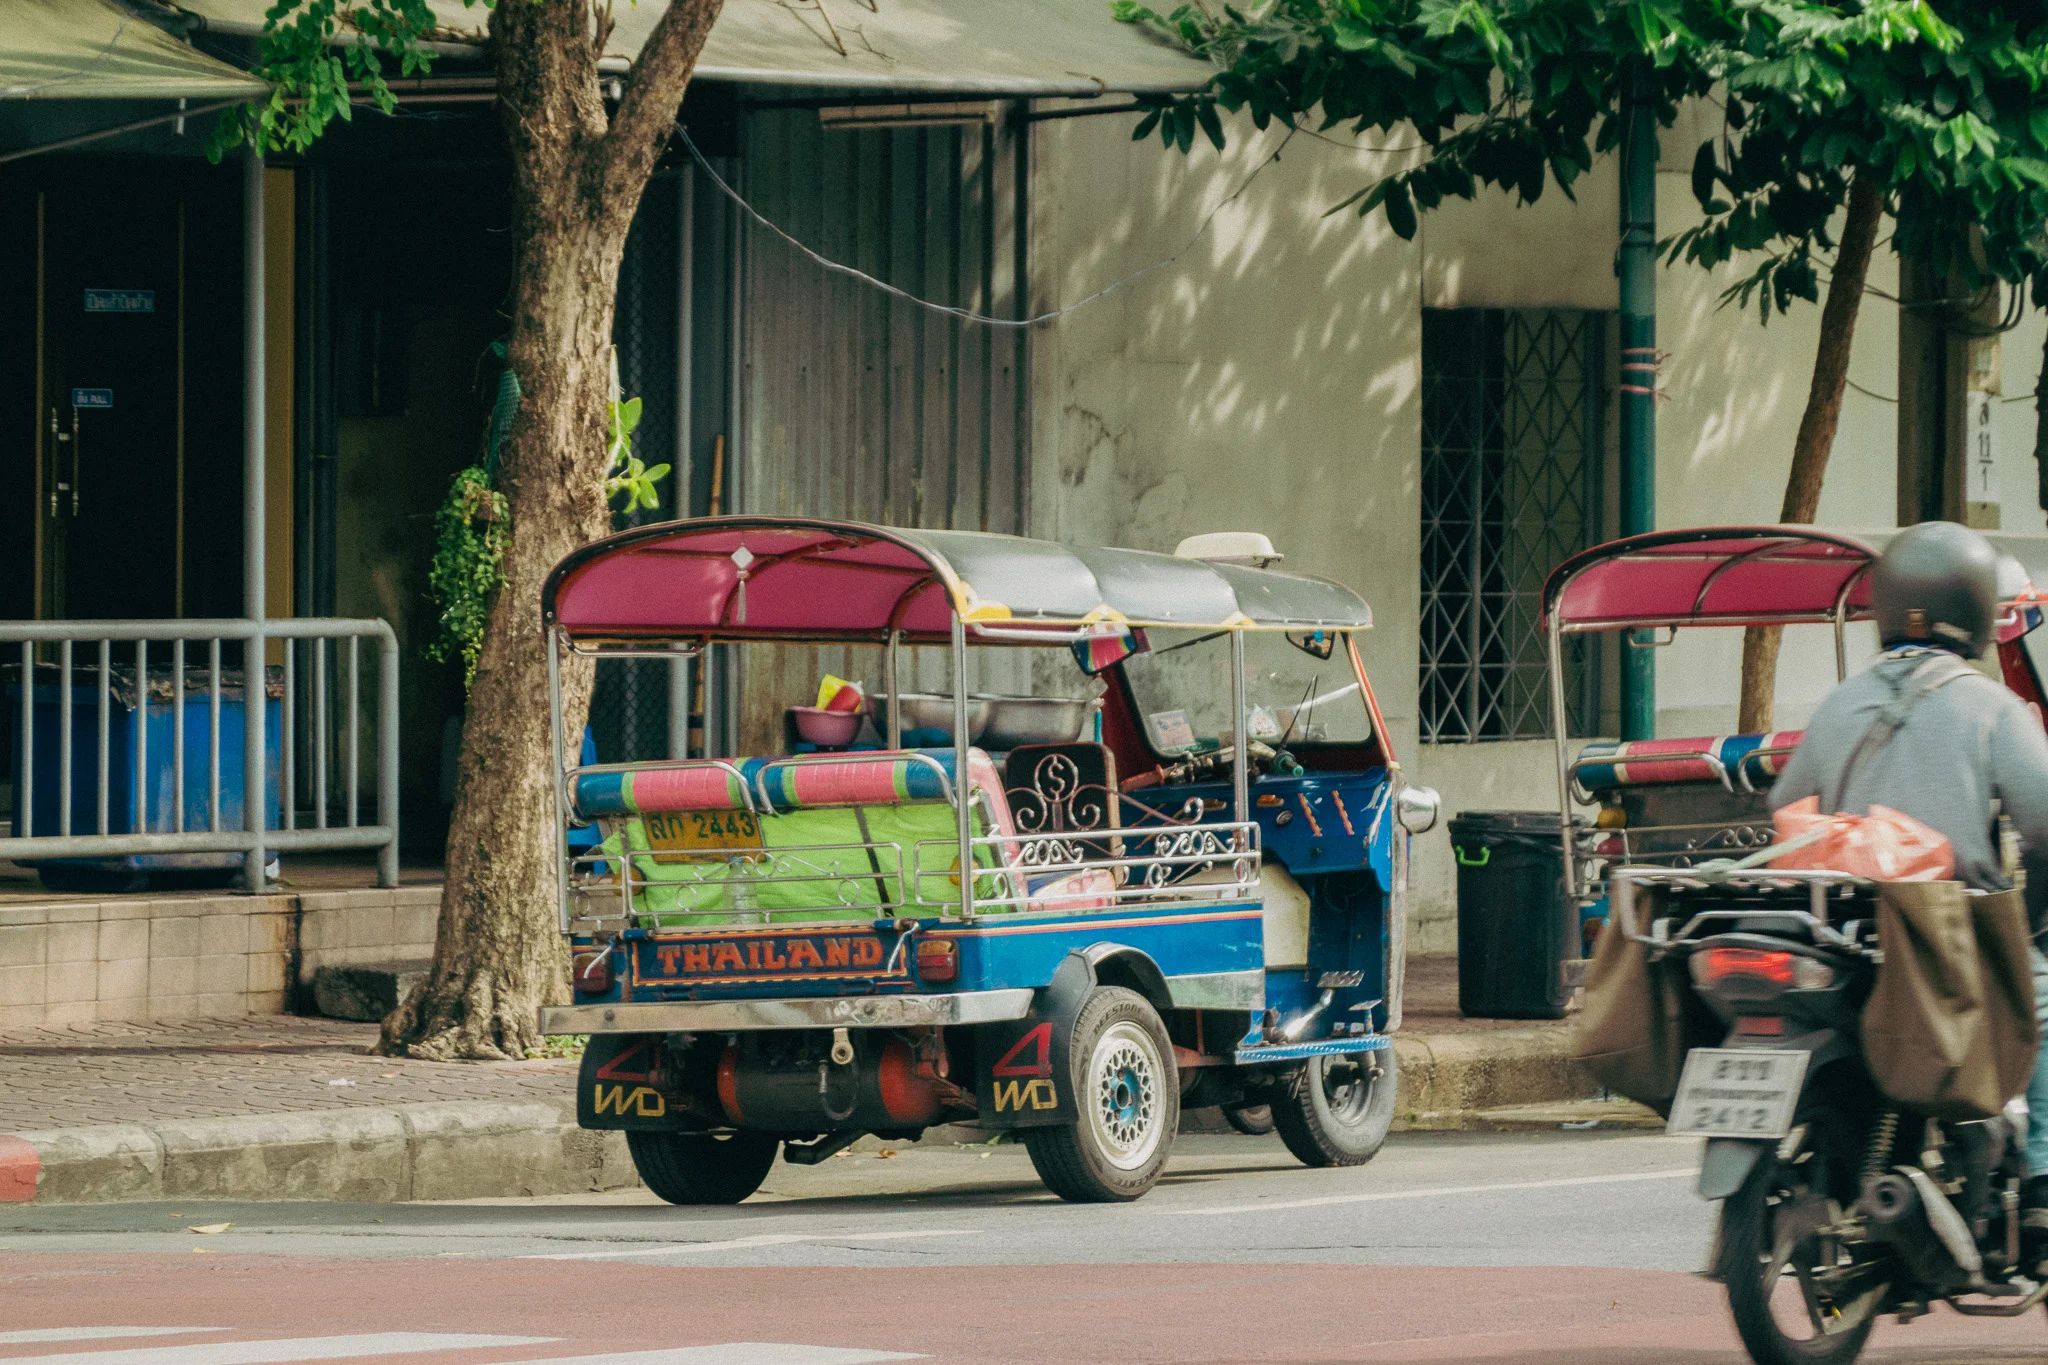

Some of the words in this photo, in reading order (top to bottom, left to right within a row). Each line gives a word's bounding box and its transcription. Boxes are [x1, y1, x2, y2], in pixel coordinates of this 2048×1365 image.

[691, 811, 754, 839] 2443
[656, 937, 883, 974] THAILAND
[992, 1022, 1052, 1078] 4
[594, 1084, 665, 1117] WD
[993, 1079, 1058, 1112] WD
